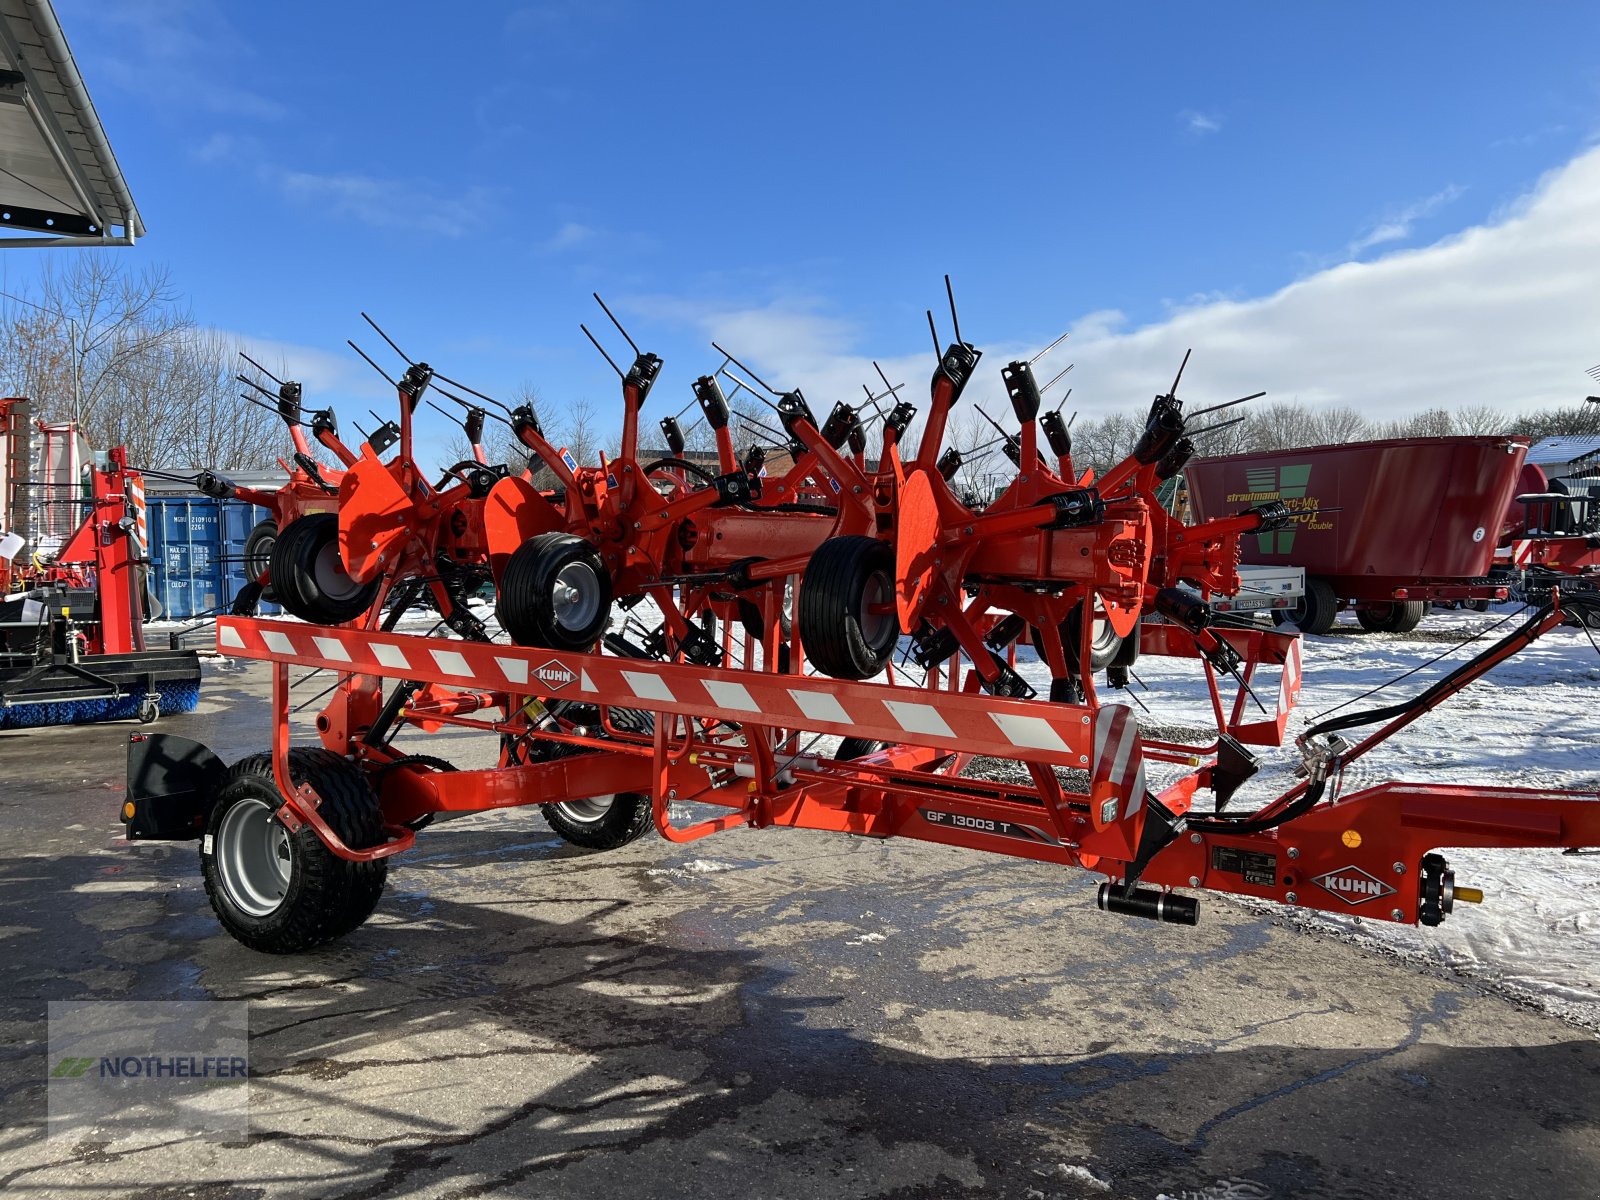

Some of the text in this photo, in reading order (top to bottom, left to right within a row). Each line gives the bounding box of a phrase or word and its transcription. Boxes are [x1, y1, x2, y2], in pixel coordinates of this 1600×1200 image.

[1226, 492, 1280, 503] strautmann
[1282, 497, 1320, 509] erti-Mix
[1308, 520, 1334, 530] Double
[540, 669, 571, 682] KUHN
[927, 811, 1011, 833] GF 13003 T
[1325, 876, 1381, 895] KUHN
